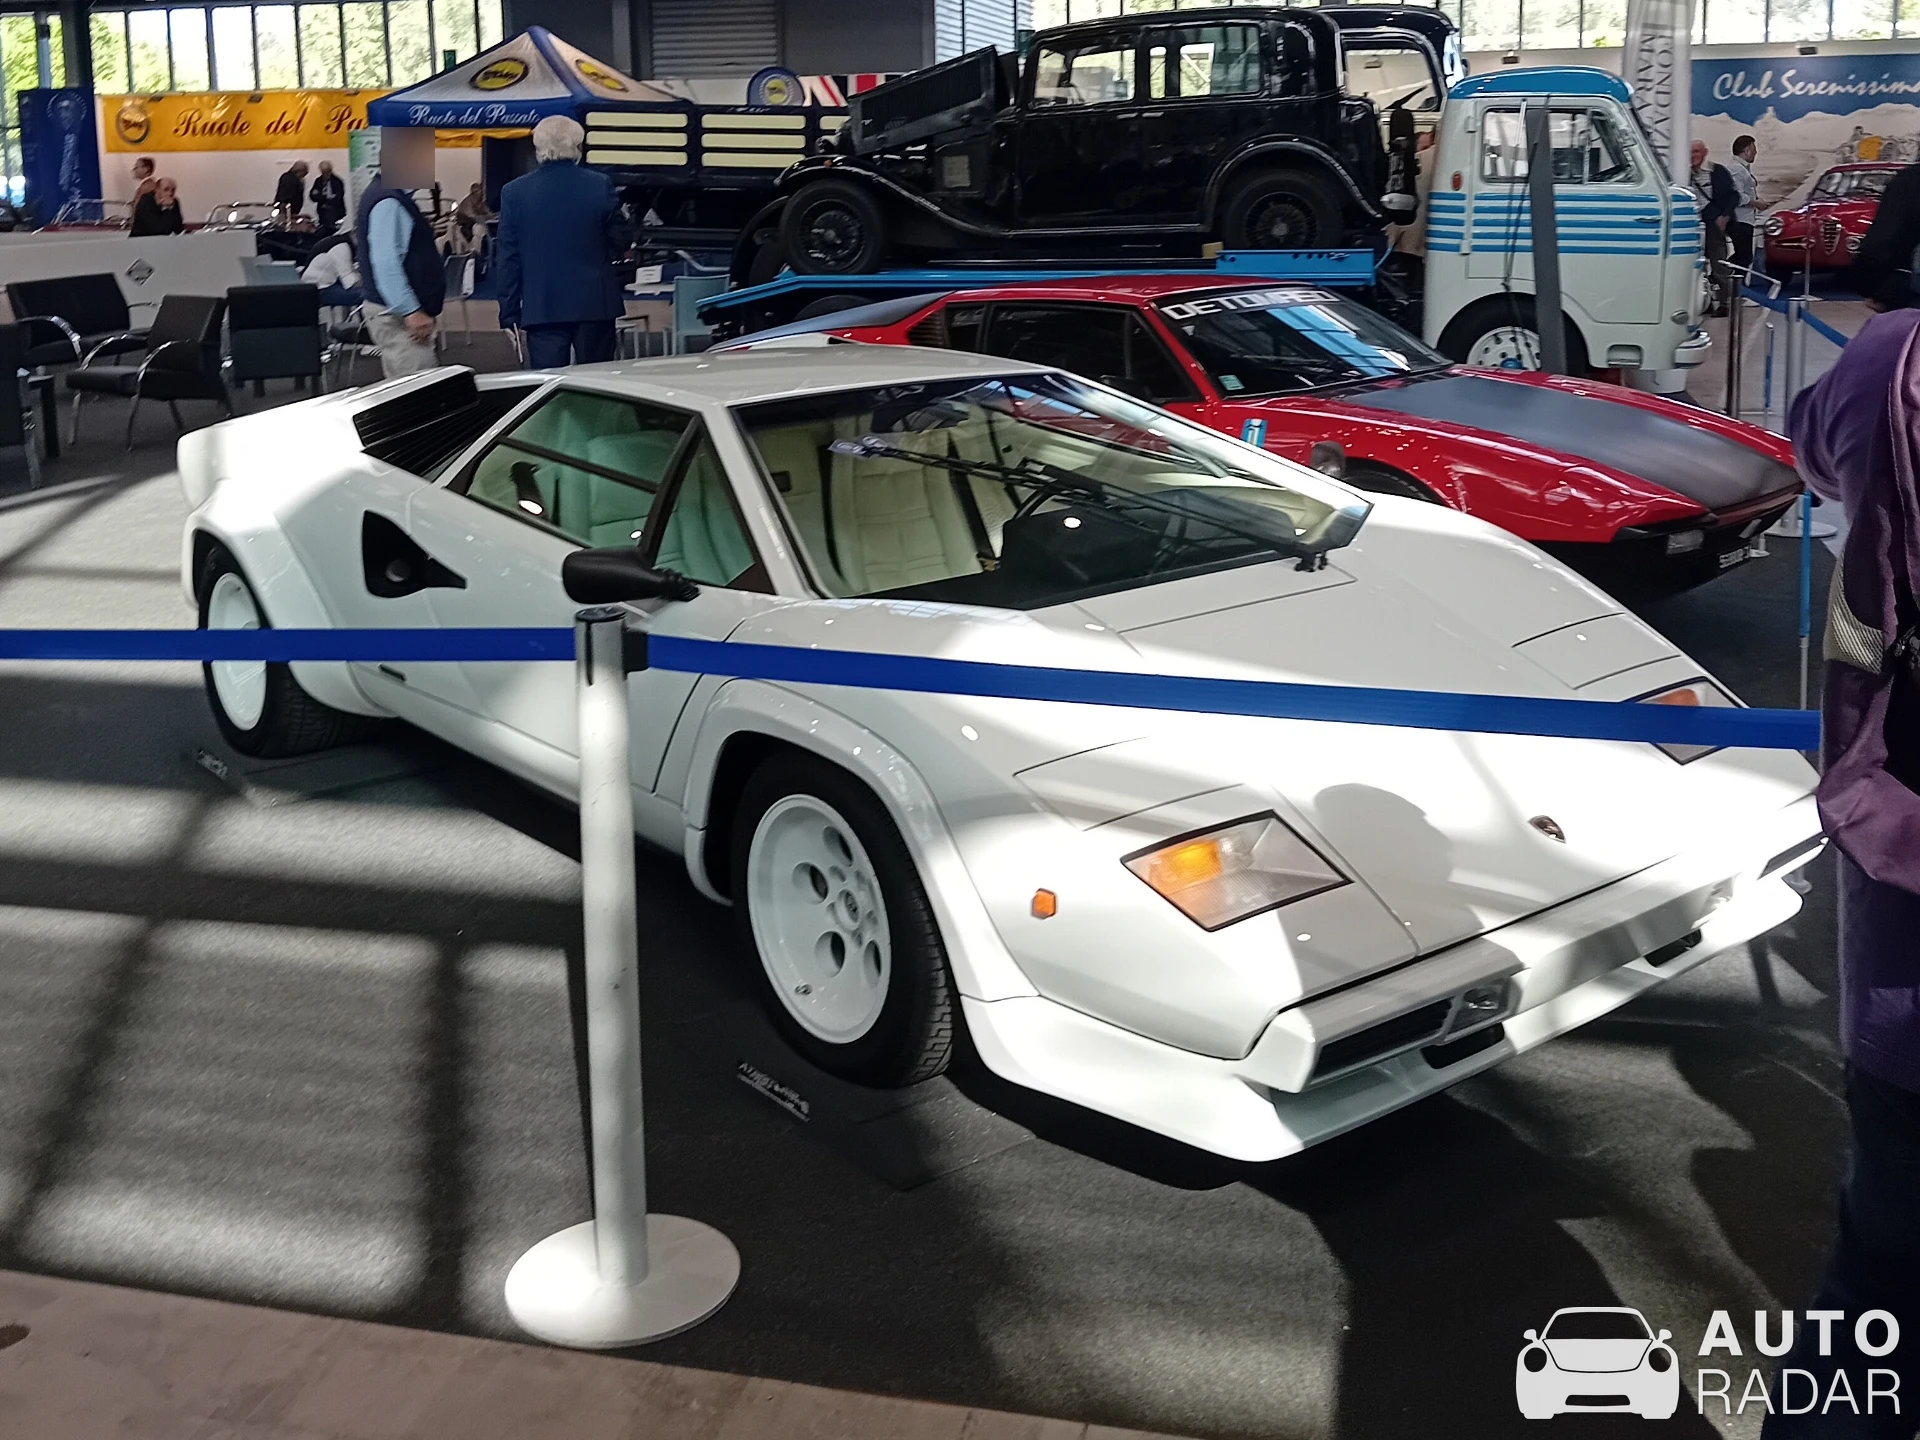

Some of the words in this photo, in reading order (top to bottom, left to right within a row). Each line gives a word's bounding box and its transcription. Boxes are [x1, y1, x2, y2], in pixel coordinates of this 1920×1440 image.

[1712, 70, 1775, 101] Club
[1779, 68, 1920, 99] Serenissim
[172, 107, 252, 138] Ruote
[264, 106, 308, 137] del
[407, 103, 456, 126] Ruote
[458, 105, 485, 125] del
